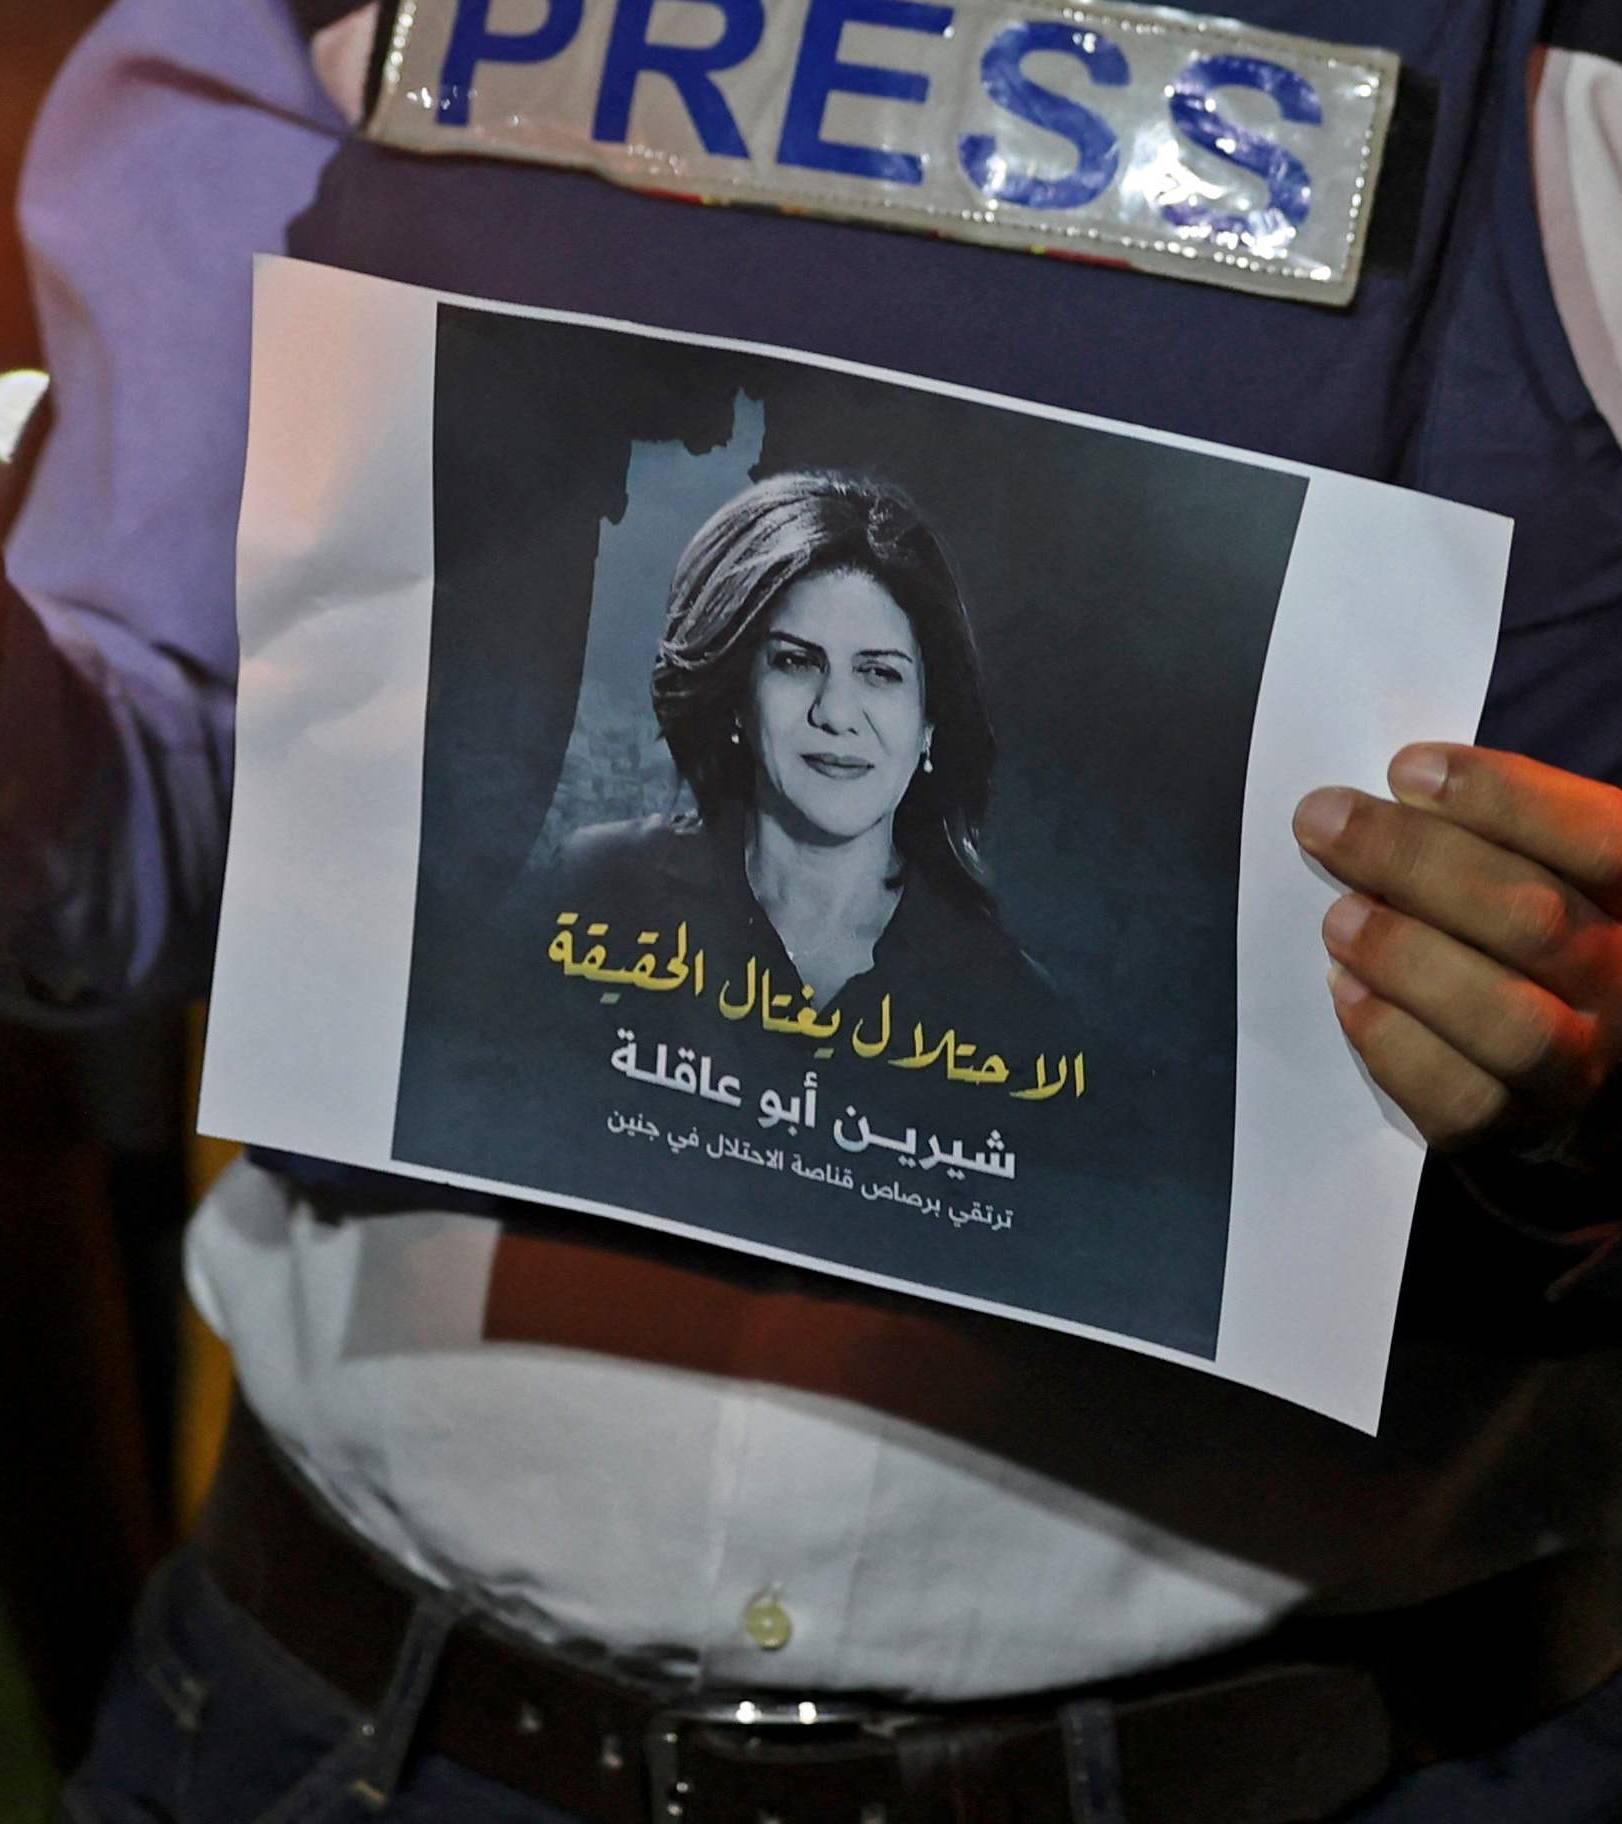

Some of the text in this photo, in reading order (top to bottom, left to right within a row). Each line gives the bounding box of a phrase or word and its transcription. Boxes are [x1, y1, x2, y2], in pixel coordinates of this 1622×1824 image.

[547, 912, 1086, 1100] الاحتلال يغتال الحقيقة
[610, 1028, 1016, 1180] شيرين أبو عاقلة
[606, 1108, 660, 1137] جنين
[666, 1125, 700, 1154] في
[706, 1135, 784, 1171] الاحتلال
[790, 1158, 854, 1190] قناصة
[860, 1180, 941, 1219] برصاص
